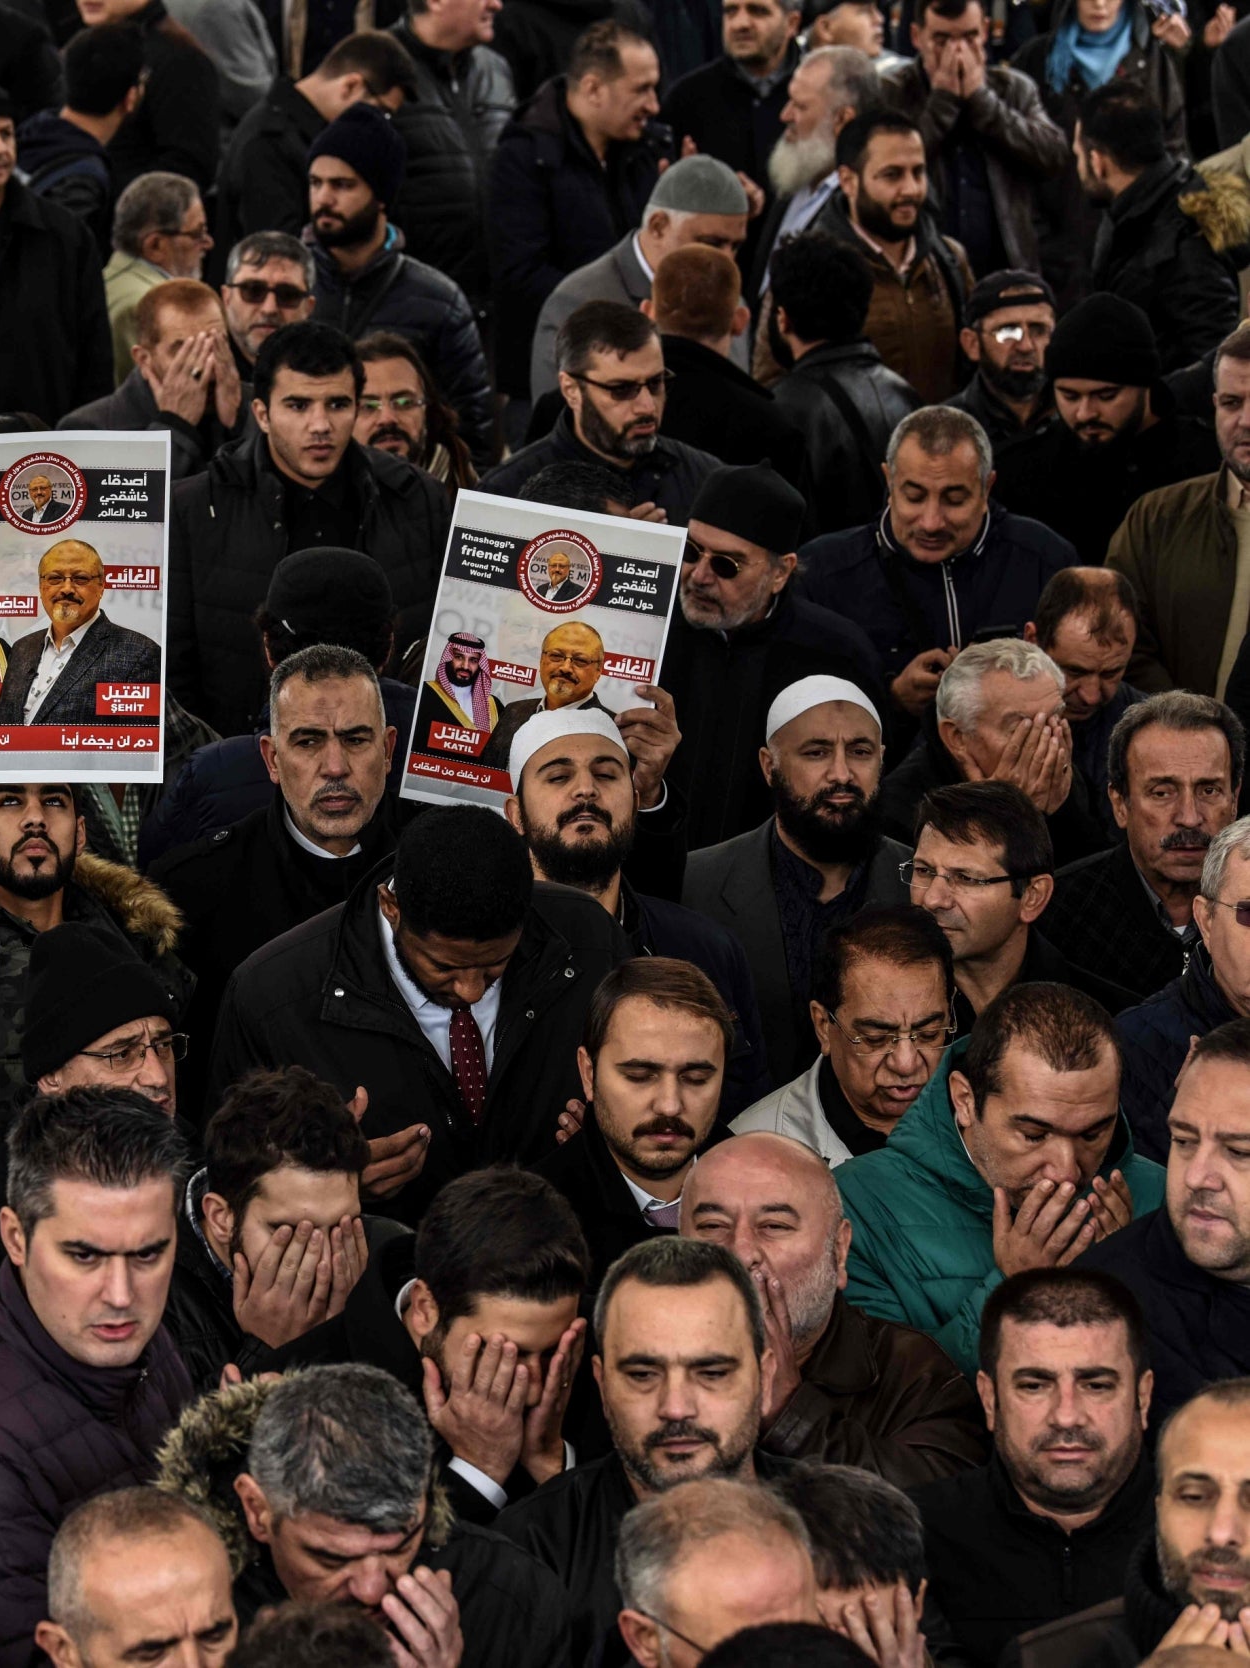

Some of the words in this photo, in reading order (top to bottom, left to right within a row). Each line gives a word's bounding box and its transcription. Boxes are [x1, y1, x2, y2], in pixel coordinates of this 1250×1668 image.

[101, 472, 147, 486] أصدقاء
[100, 488, 148, 506] خاشقجي
[98, 507, 125, 518] العالم
[128, 508, 148, 519] حول
[462, 545, 510, 564] friends
[462, 560, 489, 570] Around
[490, 565, 504, 574] The
[616, 562, 660, 579] أصدقاء
[106, 568, 155, 589] الغائب
[470, 569, 492, 579] World
[612, 580, 658, 594] خاشقجي
[608, 596, 634, 606] العالم
[635, 600, 654, 610] حول
[492, 664, 533, 679] الحاضر
[604, 658, 650, 677] الغائب
[102, 686, 150, 702] القتيل
[111, 702, 144, 714] ŞEHİT
[0, 734, 10, 746] لن
[82, 734, 114, 750] يجف
[116, 735, 130, 748] لن
[434, 726, 480, 745] القاتل
[134, 738, 154, 748] دم
[444, 741, 474, 754] KATIL
[412, 762, 440, 773] العقاب
[442, 766, 454, 777] من
[456, 770, 479, 783] يفلت
[480, 774, 491, 786] لن
